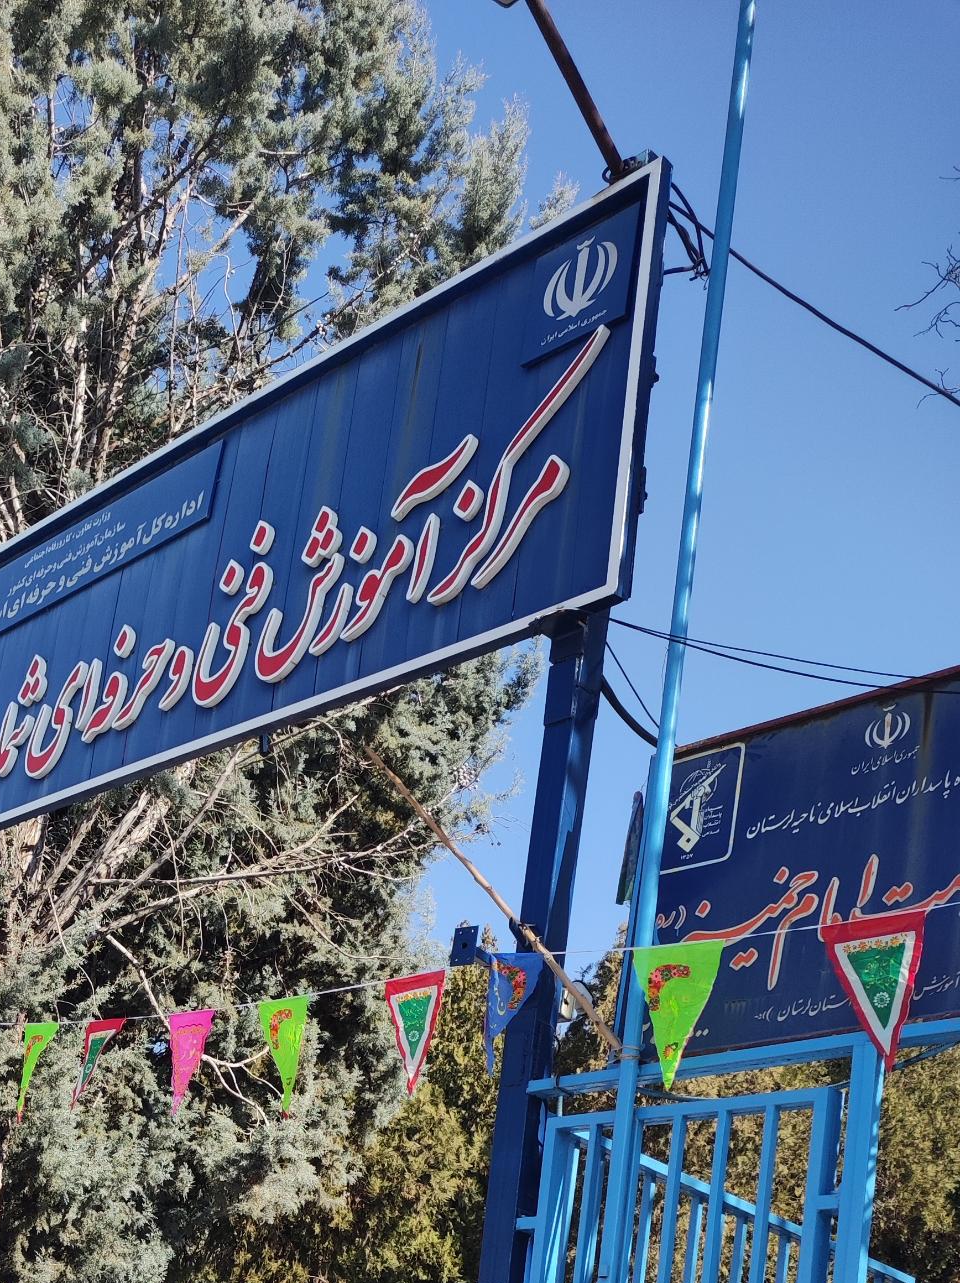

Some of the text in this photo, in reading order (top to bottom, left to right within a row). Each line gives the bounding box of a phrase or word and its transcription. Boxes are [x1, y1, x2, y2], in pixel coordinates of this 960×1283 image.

[540, 331, 558, 346] ایران
[558, 320, 581, 338] اسلامی
[426, 324, 611, 607] مرکز
[164, 489, 205, 530] اداره
[97, 521, 126, 546] سازمان
[142, 512, 167, 545] کل
[56, 549, 73, 570] فنی
[71, 533, 100, 562] آموزش
[93, 521, 147, 573] آموزش
[253, 433, 480, 685] آموزش
[7, 575, 27, 597] کشور
[55, 575, 66, 593] و
[66, 554, 92, 588] فنی
[192, 519, 275, 708] فنی
[158, 645, 195, 712] و
[851, 744, 921, 775] جمهوری اسلامی ایران
[746, 769, 951, 839] پاسداران انقلاب اسلامی ناحیه لرستان
